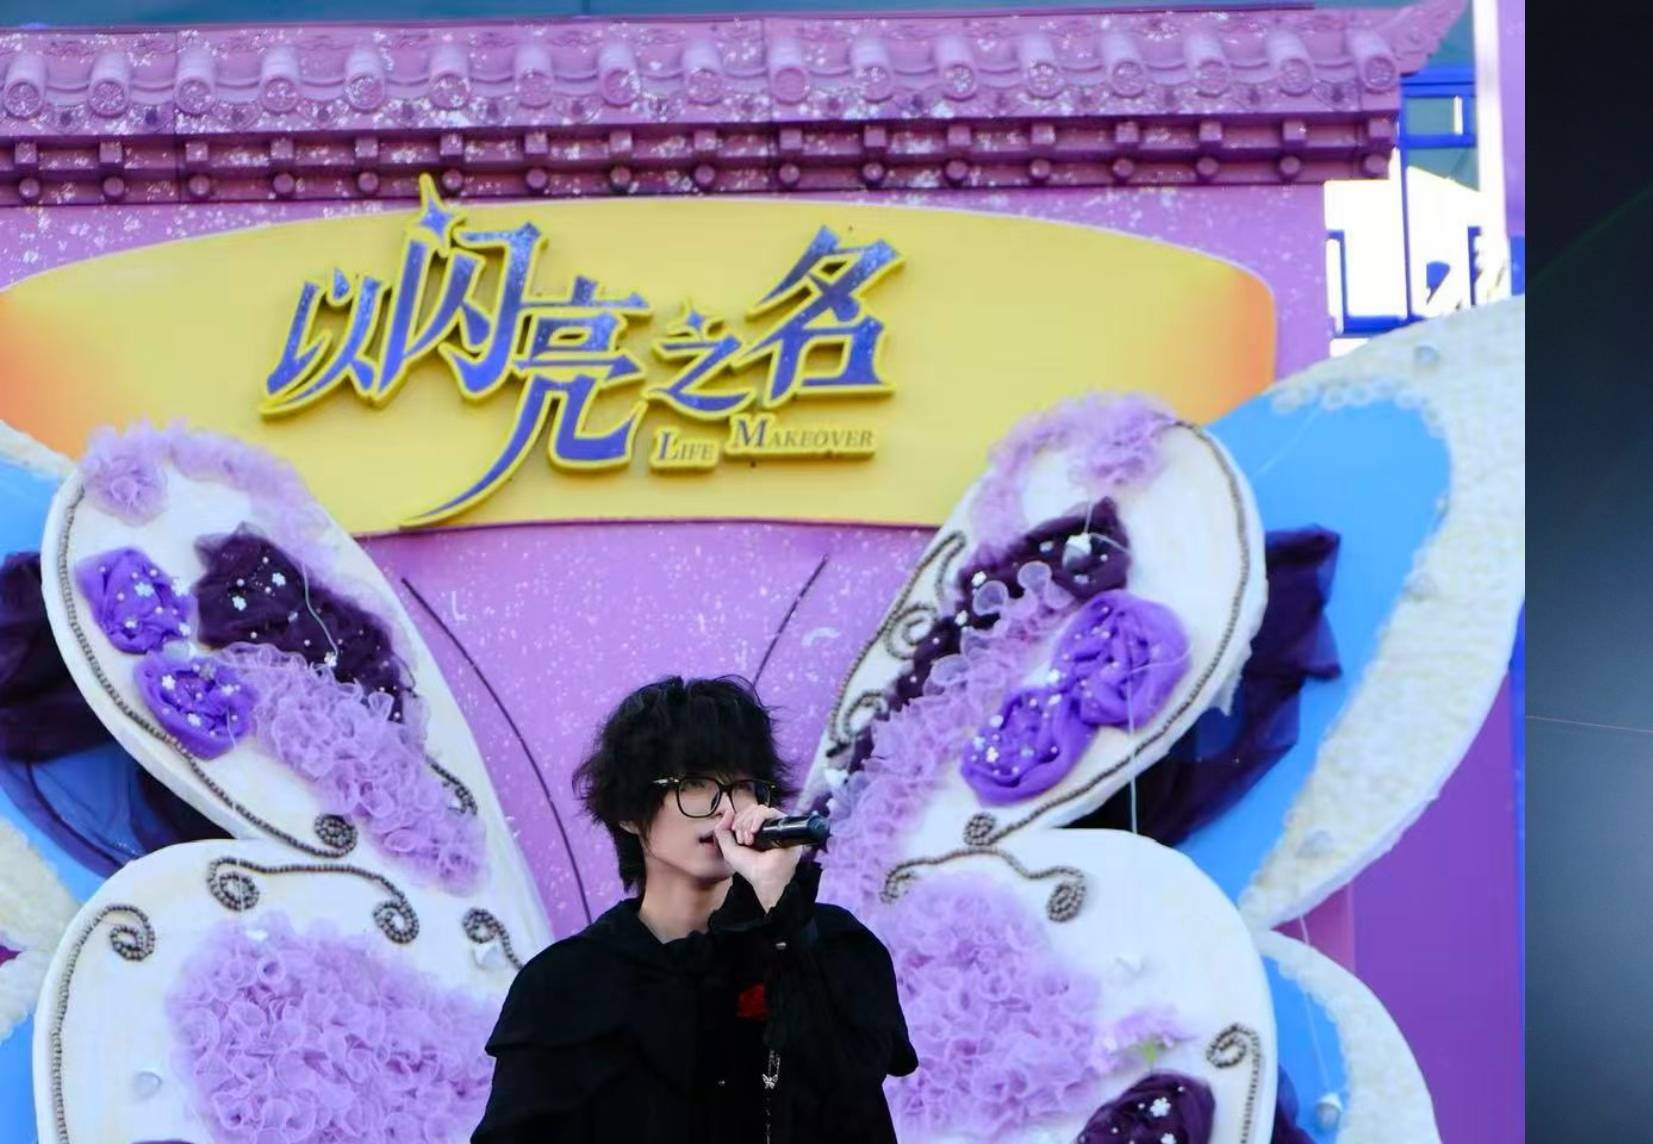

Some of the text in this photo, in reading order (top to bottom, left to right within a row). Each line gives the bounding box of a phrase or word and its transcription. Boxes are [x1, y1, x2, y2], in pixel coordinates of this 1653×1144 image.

[263, 195, 902, 524] 以闪亮之名
